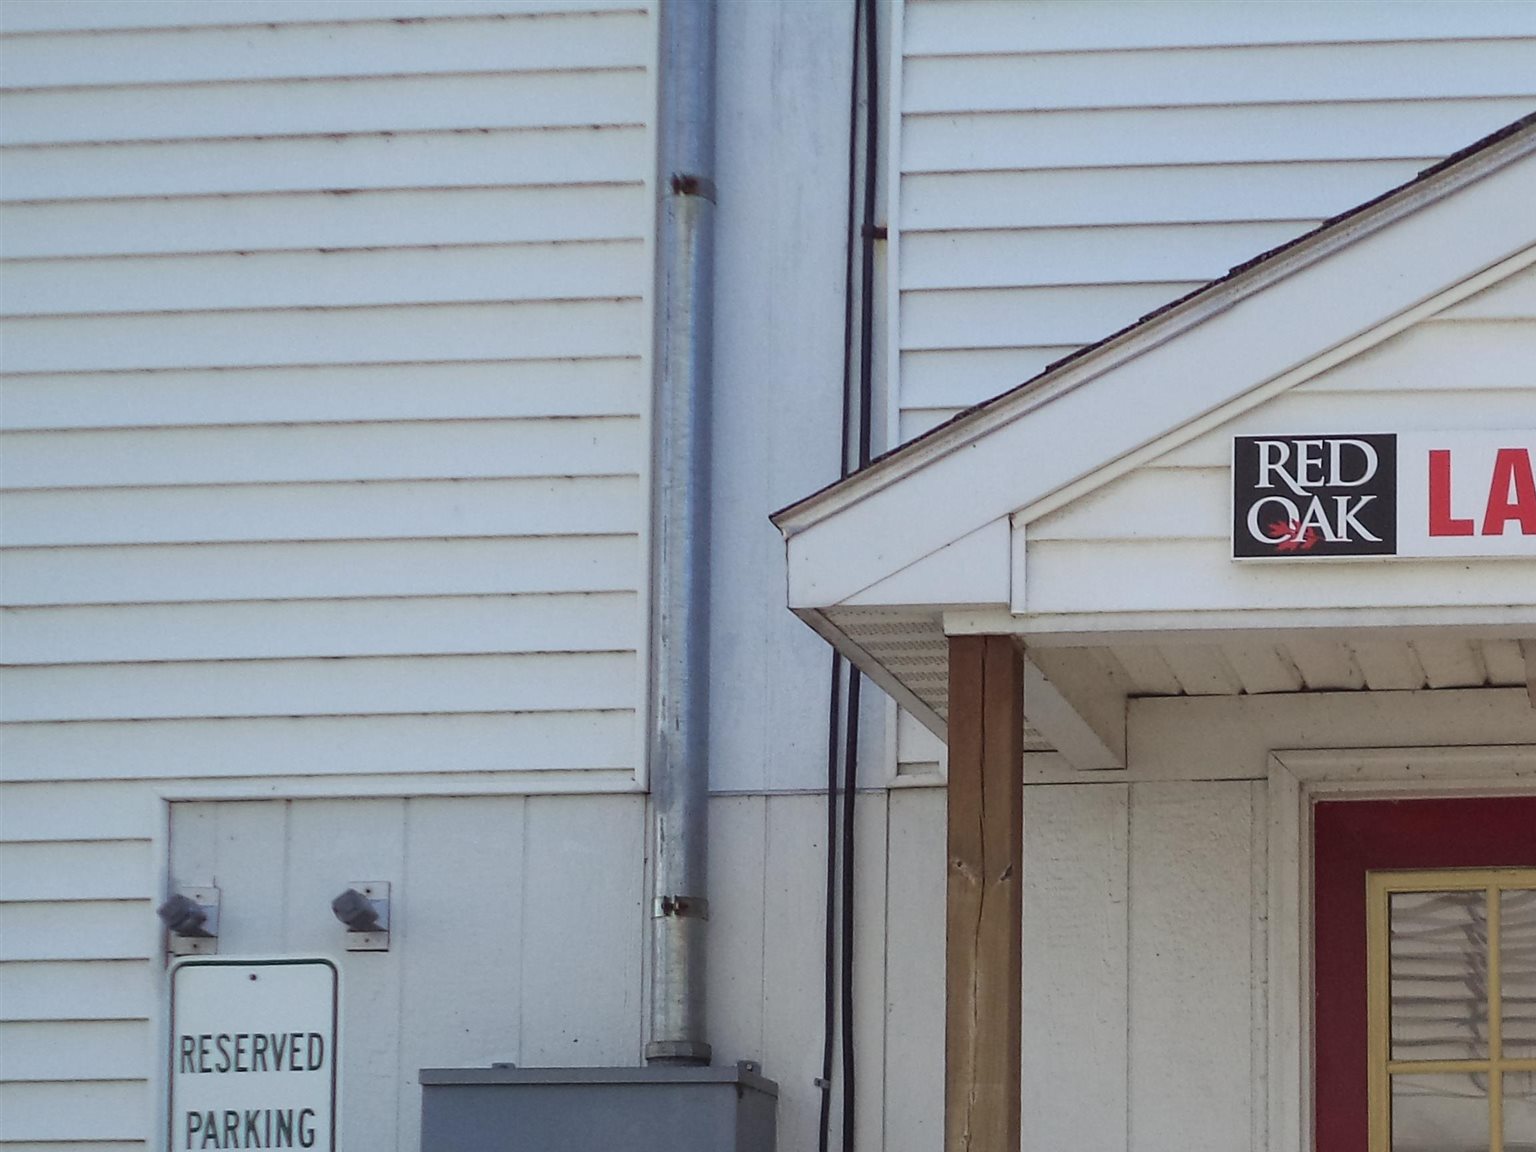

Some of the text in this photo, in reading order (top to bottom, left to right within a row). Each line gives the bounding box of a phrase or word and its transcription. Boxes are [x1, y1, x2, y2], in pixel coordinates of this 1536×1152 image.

[1254, 439, 1378, 496] RED
[1247, 495, 1383, 544] OAK
[180, 1033, 324, 1074] RESERVED
[186, 1108, 316, 1150] PARKING
